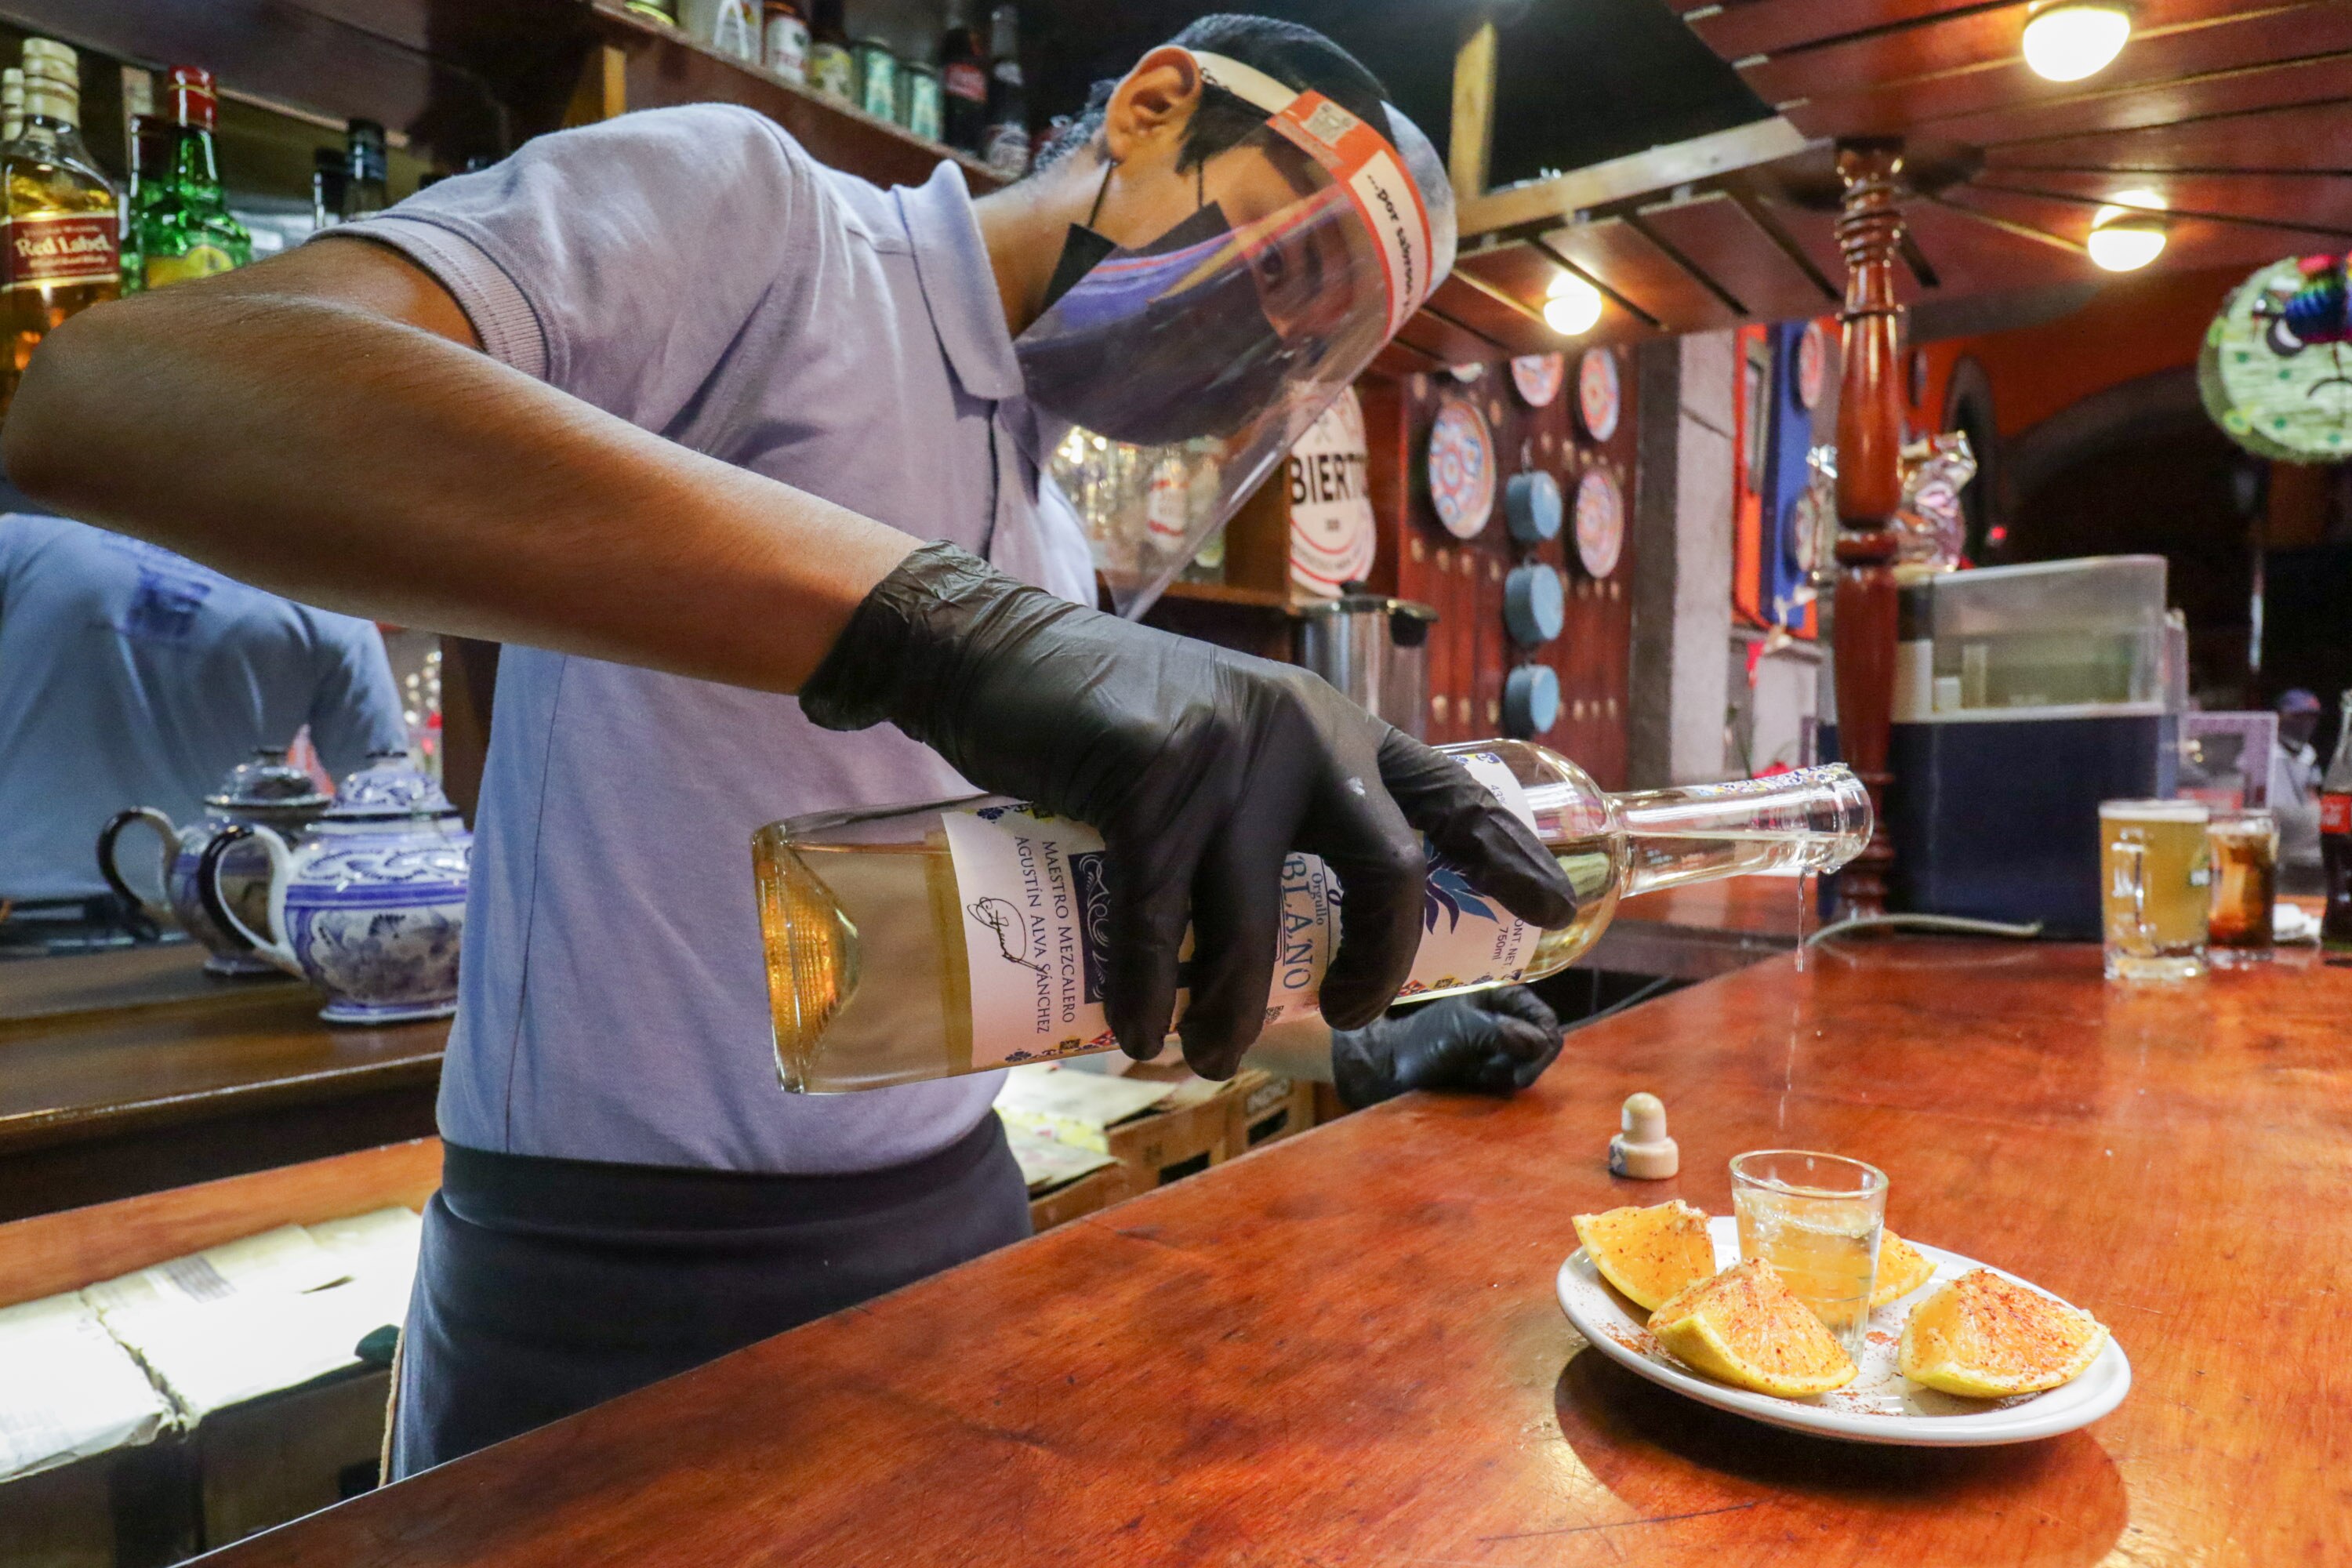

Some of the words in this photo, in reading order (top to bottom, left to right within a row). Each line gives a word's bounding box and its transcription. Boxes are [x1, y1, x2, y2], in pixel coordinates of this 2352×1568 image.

[14, 236, 57, 258] Red
[1290, 453, 1368, 504] BIERT
[1015, 836, 1042, 908] AGUSTÍN
[1281, 855, 1314, 989] BLANO
[1312, 872, 1327, 926] Orgullo
[1030, 914, 1047, 959] ALVA
[1042, 840, 1069, 919] MAESTRO
[1058, 926, 1076, 1023] MEZCALERO
[1492, 926, 1509, 961] 750ml
[1511, 917, 1525, 946] ONT.
[1036, 963, 1051, 1034] SÁNCHEZ
